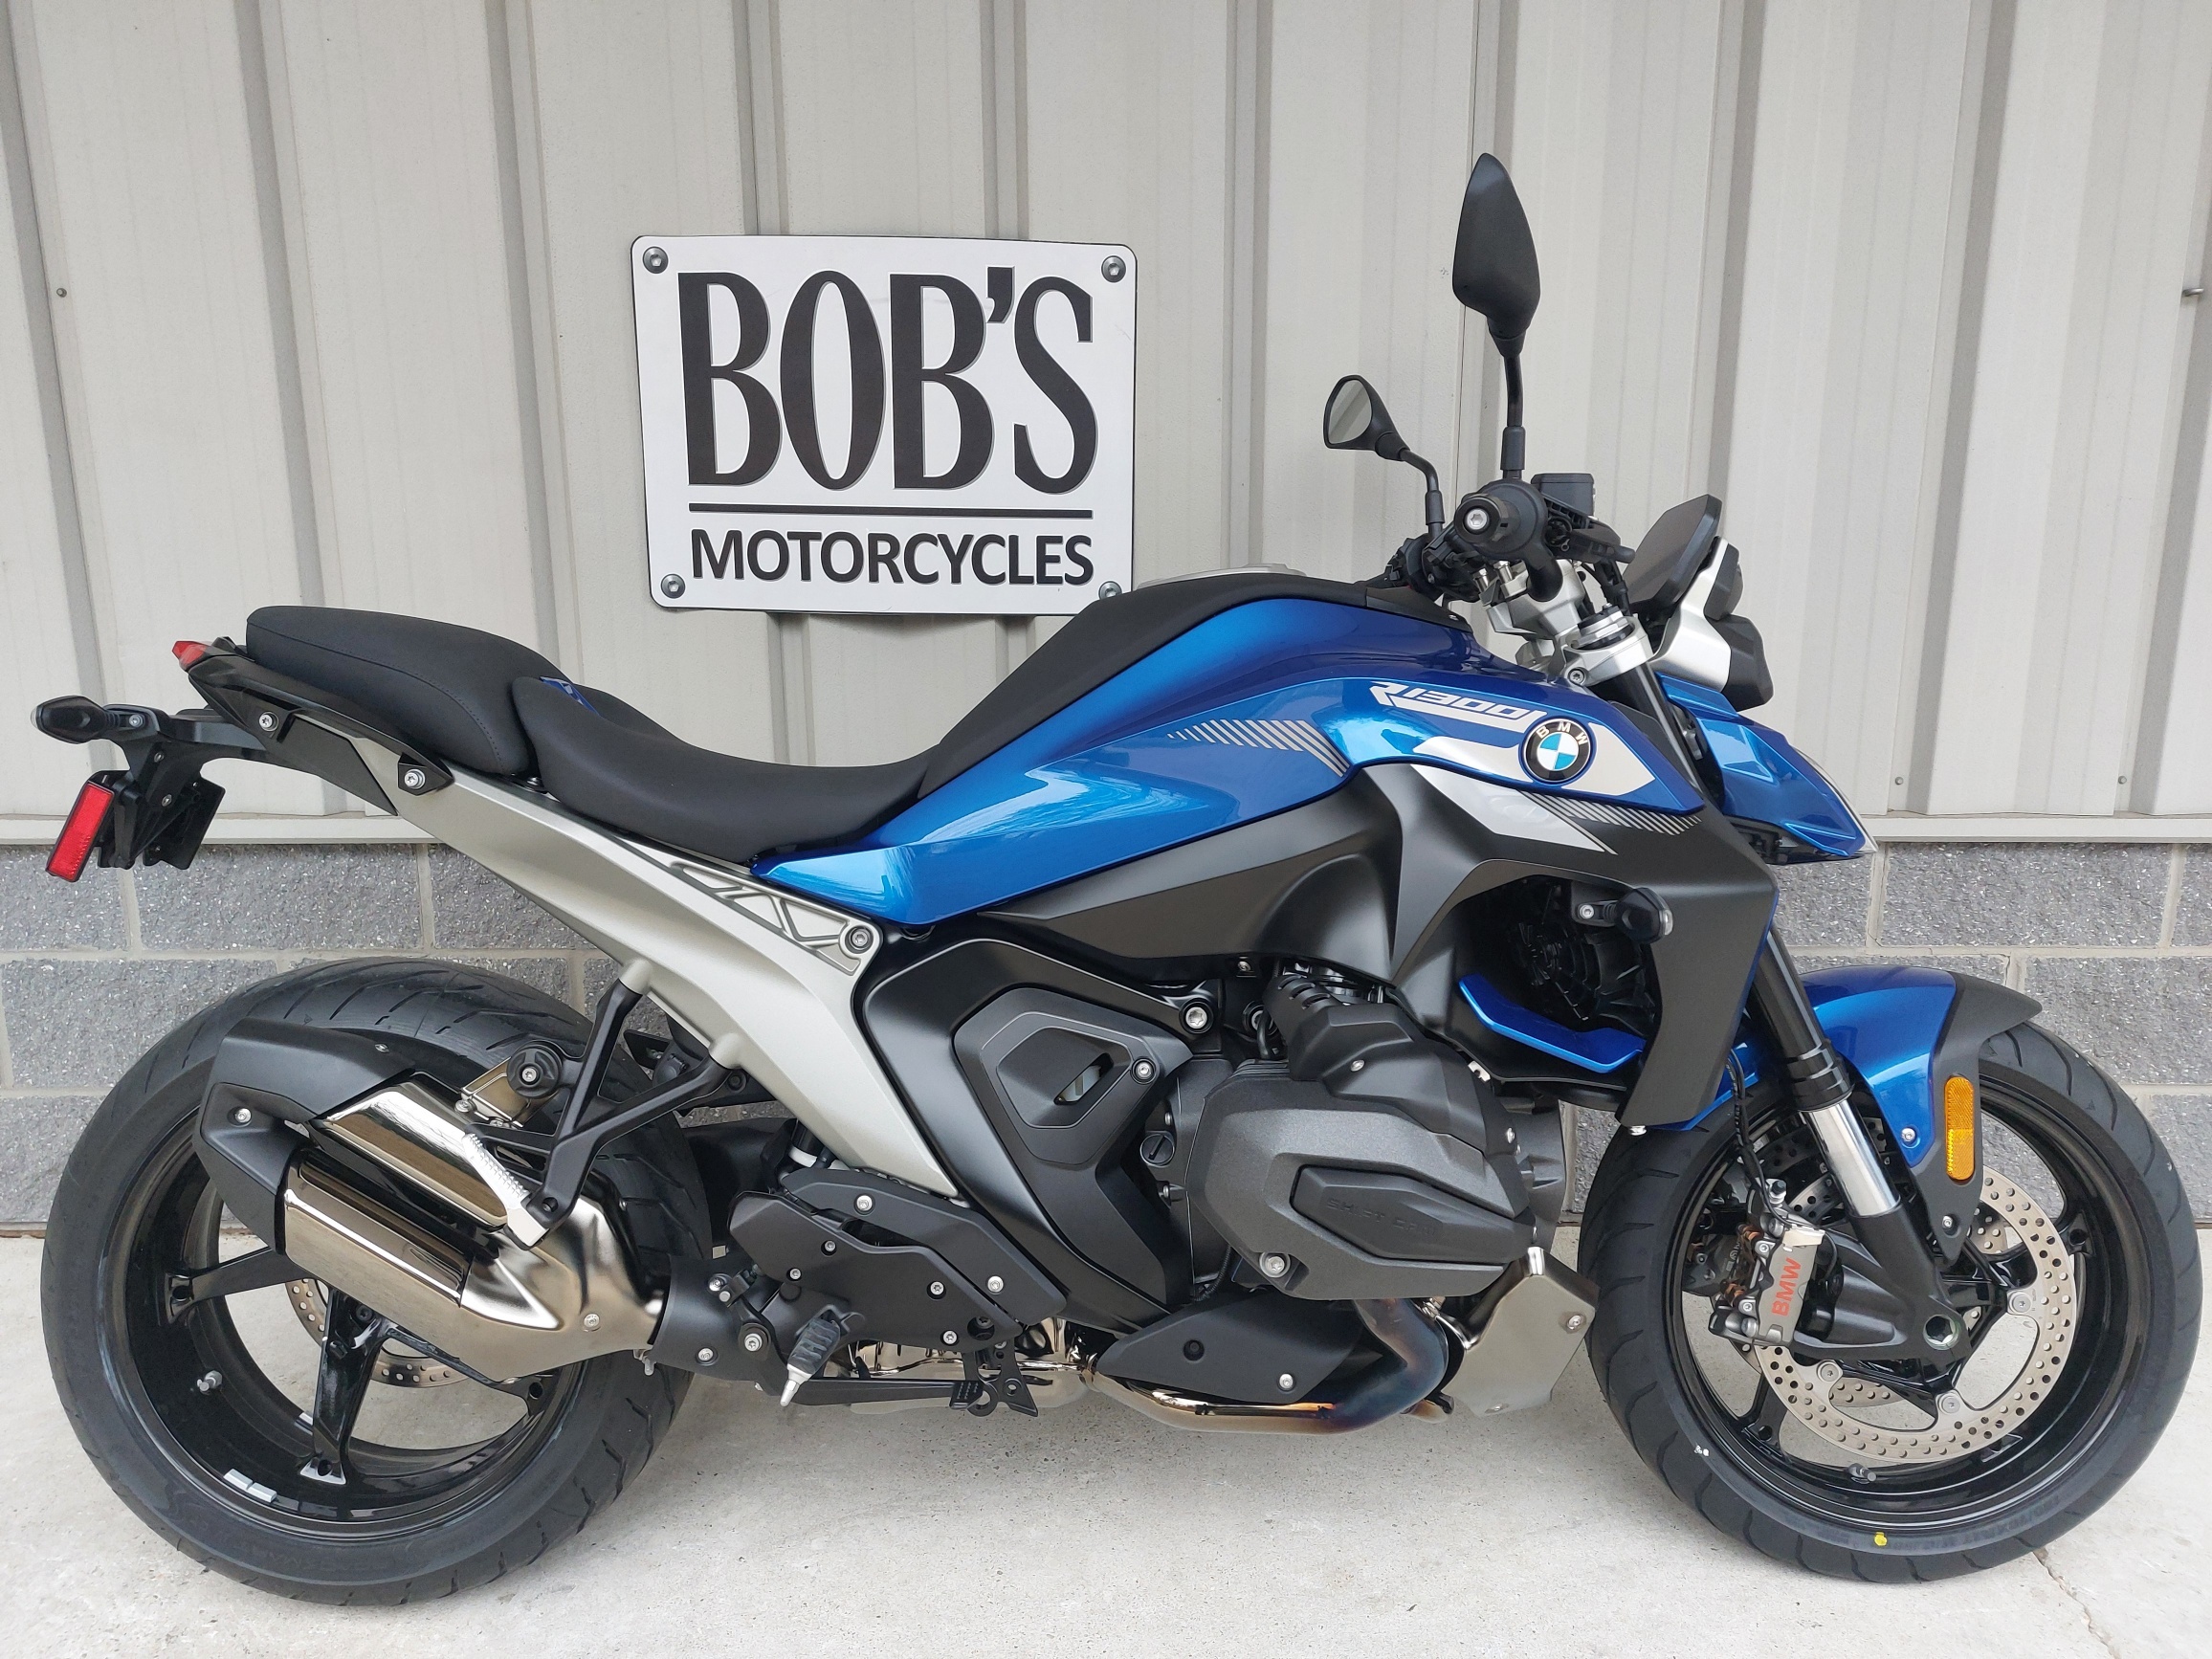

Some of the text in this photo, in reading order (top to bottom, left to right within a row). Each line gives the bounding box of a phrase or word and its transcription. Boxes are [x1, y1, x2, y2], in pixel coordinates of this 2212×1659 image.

[677, 266, 1098, 496] BOB'S
[691, 528, 1095, 586] MOTORCYCLES
[1536, 720, 1589, 745] BMW
[1325, 1197, 1386, 1224] SHIFT
[1772, 1257, 1801, 1316] BMW
